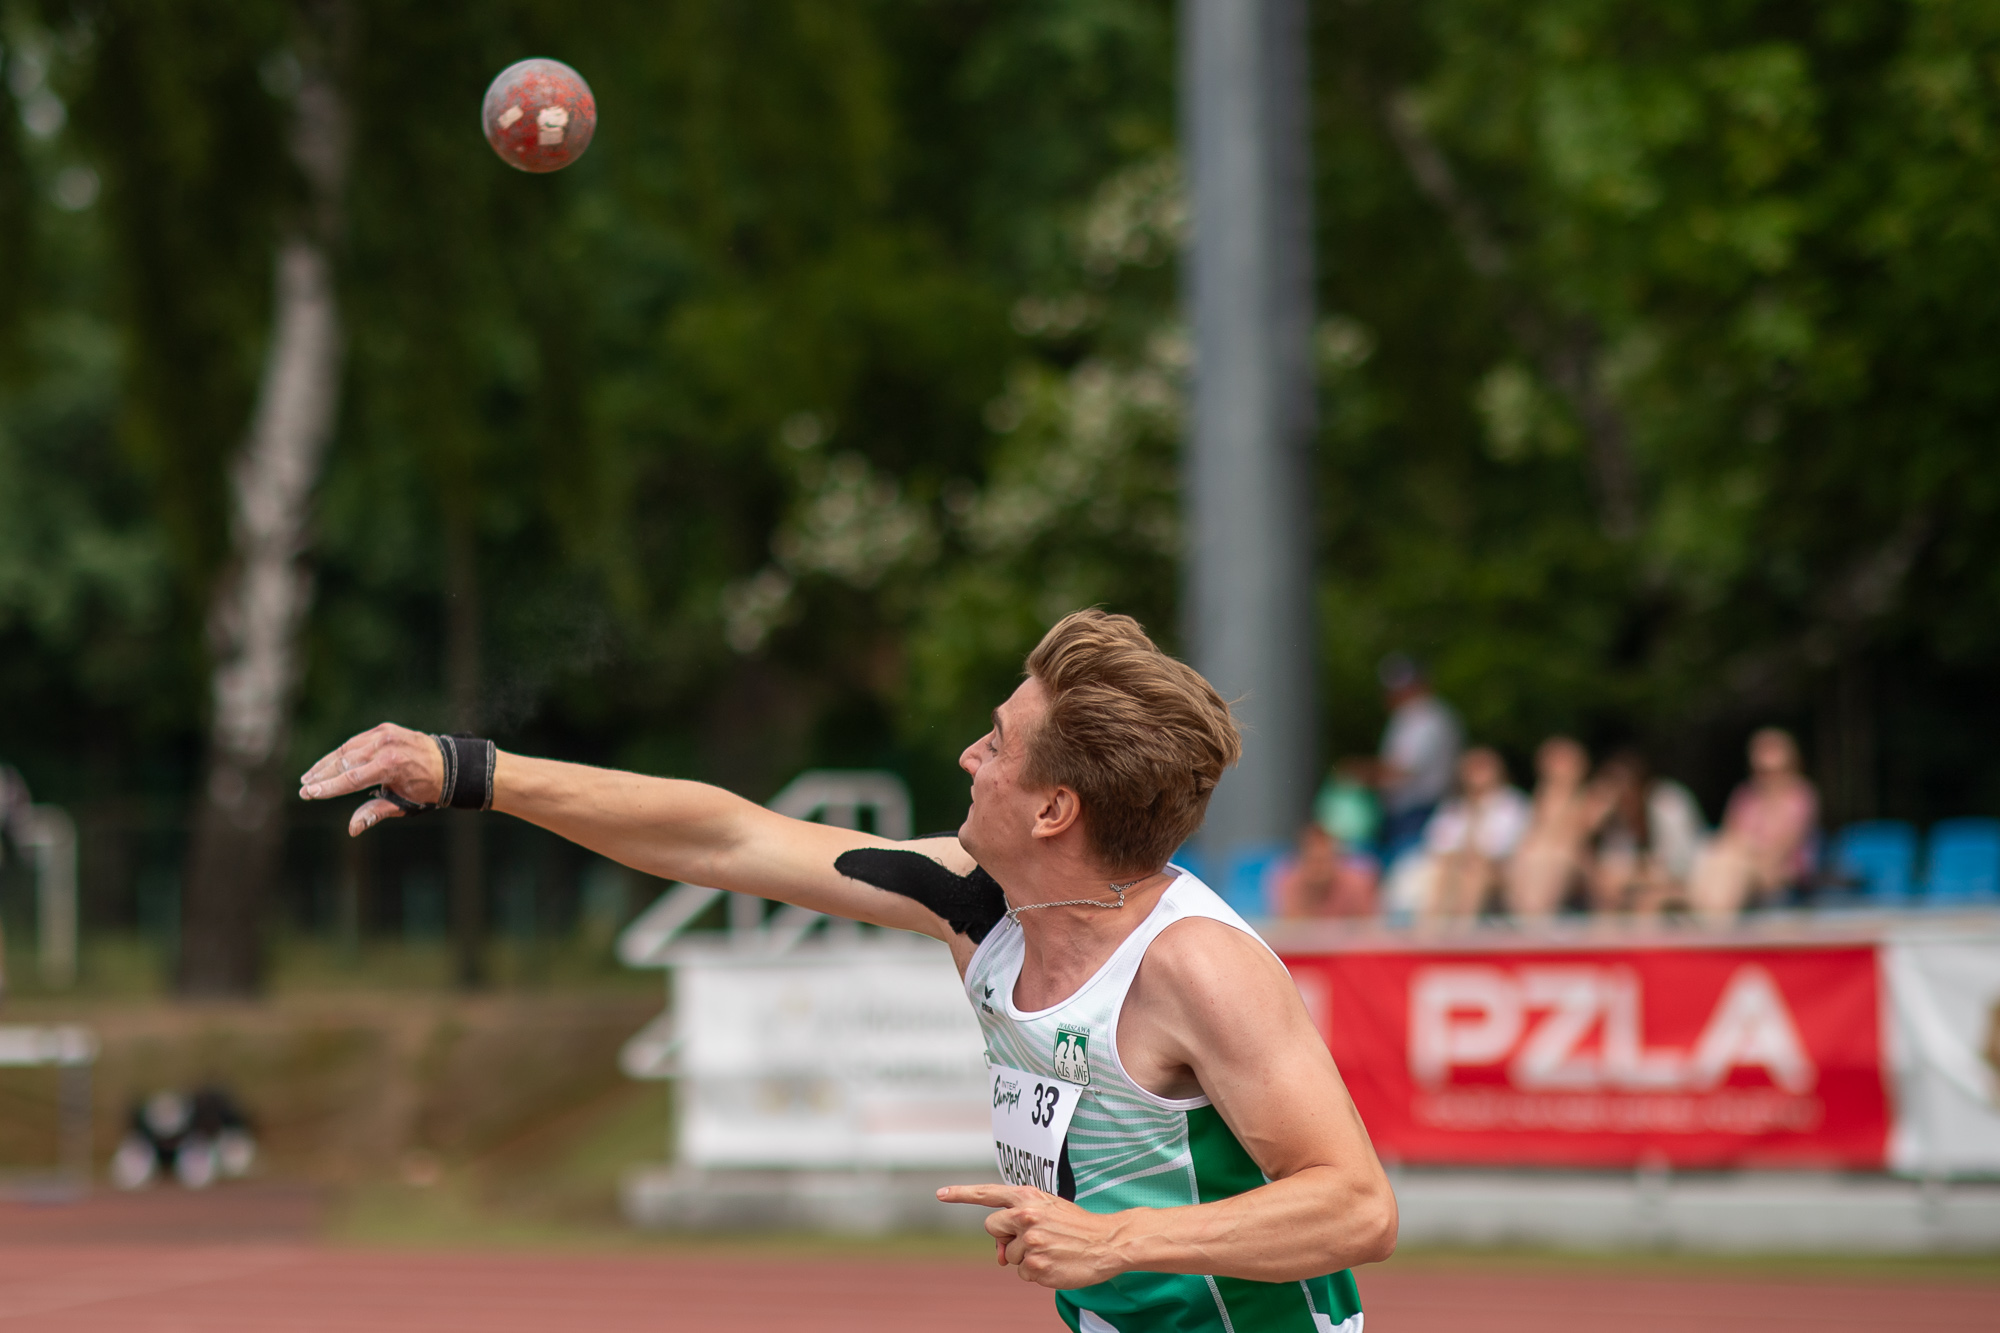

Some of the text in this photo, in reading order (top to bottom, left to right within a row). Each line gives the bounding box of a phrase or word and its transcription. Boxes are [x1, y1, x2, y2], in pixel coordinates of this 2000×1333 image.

[1058, 1022, 1090, 1034] WARSZAWA
[1407, 963, 1817, 1093] PZLA
[1057, 1061, 1088, 1082] AZS AWF
[1031, 1082, 1060, 1128] 33
[996, 1140, 1056, 1196] TARASIEWICZ
